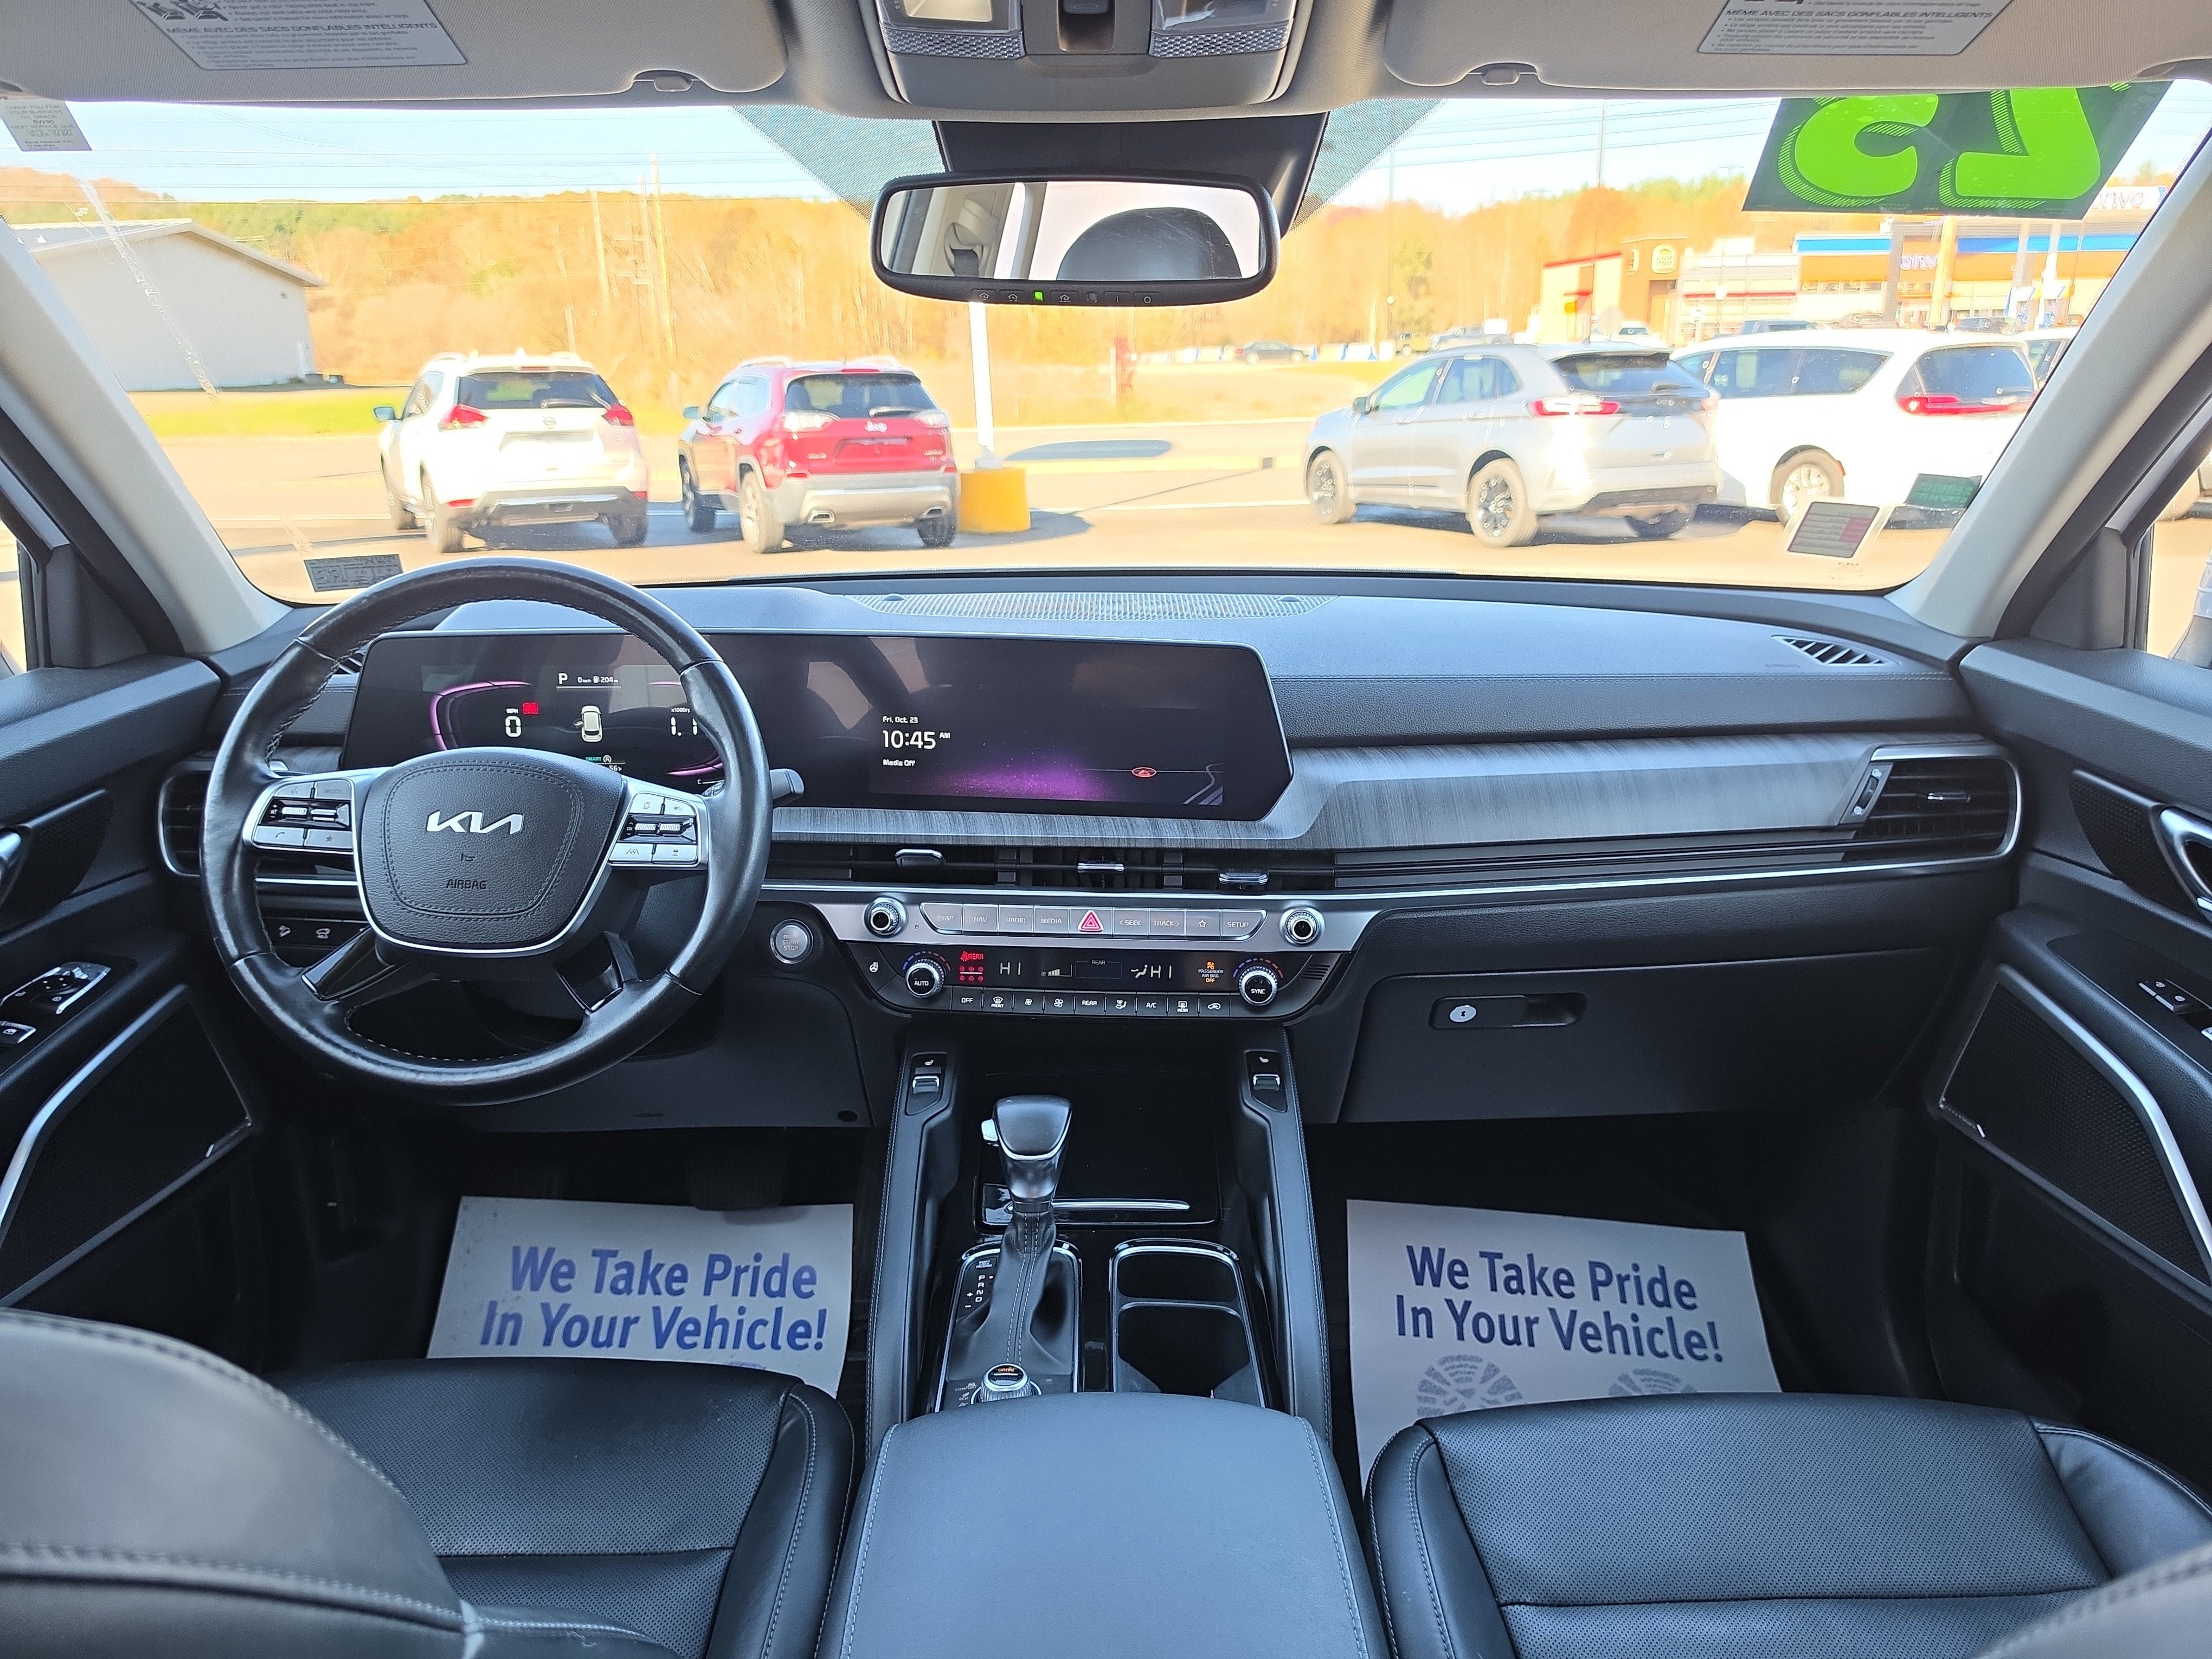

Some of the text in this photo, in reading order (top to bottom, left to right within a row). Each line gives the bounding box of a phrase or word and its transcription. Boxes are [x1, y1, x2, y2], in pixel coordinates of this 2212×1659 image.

[558, 673, 568, 684] P
[505, 716, 521, 737] 0
[882, 730, 936, 749] 10:45
[426, 809, 524, 835] KIA
[446, 879, 487, 889] AIRBAG
[511, 1245, 818, 1299] We Take Pride
[1405, 1245, 1698, 1311] We Take Pride
[479, 1301, 828, 1352] In Your Vehicle!
[1394, 1294, 1724, 1364] In Your Vehicle!
